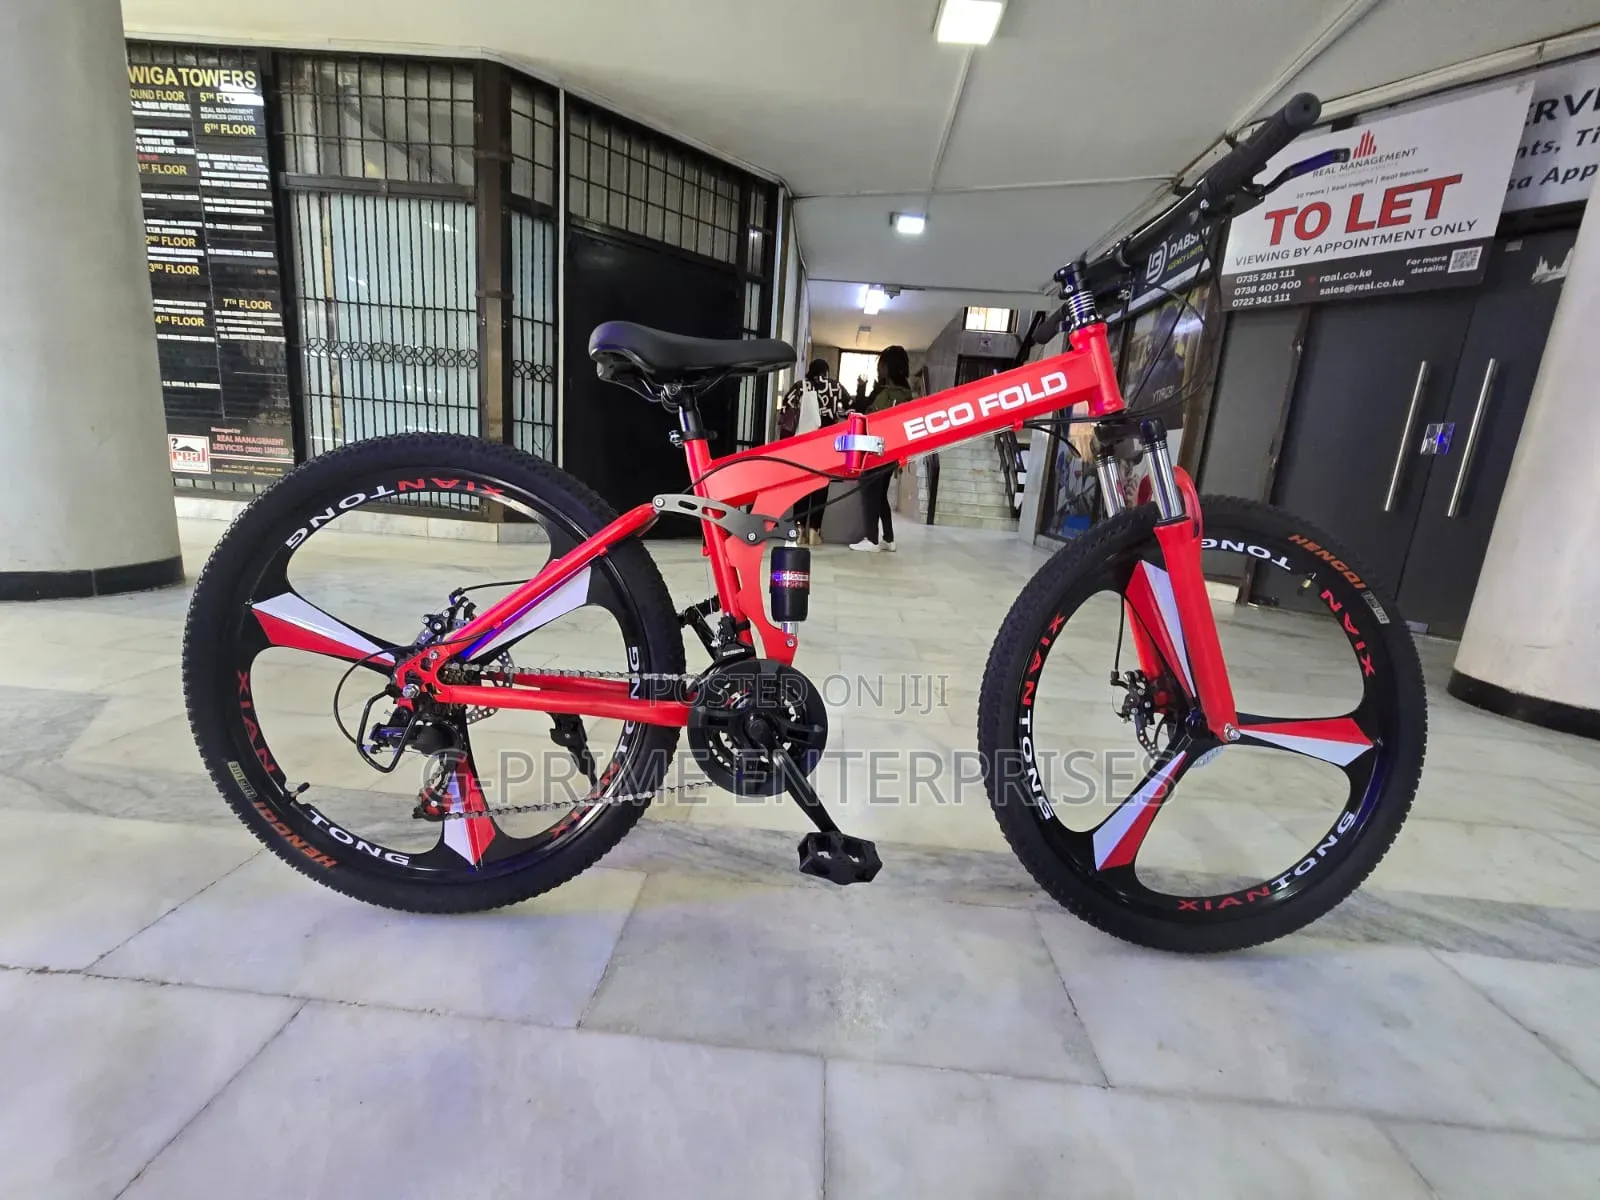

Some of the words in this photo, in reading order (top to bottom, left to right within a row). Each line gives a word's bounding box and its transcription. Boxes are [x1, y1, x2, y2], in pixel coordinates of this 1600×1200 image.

[178, 67, 257, 89] TOWERS
[156, 90, 185, 102] FLOOR
[200, 92, 214, 103] 5TH
[204, 122, 219, 133] 6TH
[221, 123, 256, 135] FLOOR
[138, 163, 149, 173] 1ST
[151, 164, 187, 175] FLOOR
[1312, 167, 1336, 178] REAL
[1339, 147, 1419, 173] MANAGEMENT
[1264, 201, 1332, 246] TO
[1344, 173, 1463, 234] LET
[145, 235, 159, 245] 2ND
[161, 236, 196, 247] FLOOR
[1235, 249, 1290, 266] VIEWING
[1292, 245, 1311, 258] BY
[1313, 228, 1427, 254] APPOINTMENT
[1430, 218, 1478, 237] ONLY
[1406, 257, 1421, 266] For
[1422, 254, 1448, 264] more
[148, 263, 163, 273] 3RD
[165, 264, 200, 276] FLOOR
[1235, 273, 1260, 284] 0735
[1260, 271, 1278, 281] 281
[1279, 269, 1296, 279] 111
[1319, 268, 1372, 283] real.co.ke
[1258, 283, 1279, 293] 400
[1280, 280, 1302, 290] 400
[1319, 278, 1405, 296] sales@real.co.ke
[223, 298, 237, 308] 7TH
[238, 299, 273, 310] FLOOR
[1231, 297, 1255, 308] 0722
[1255, 295, 1273, 305] 341
[1274, 293, 1291, 302] 111
[155, 315, 169, 325] 4TH
[171, 316, 205, 327] FLOOR
[903, 401, 975, 441] ECO
[978, 371, 1068, 417] FOLD
[1288, 534, 1368, 589] HENGQI
[1320, 589, 1376, 677] XIAN
[237, 670, 277, 774] XIAN
[310, 809, 410, 866] TONG
